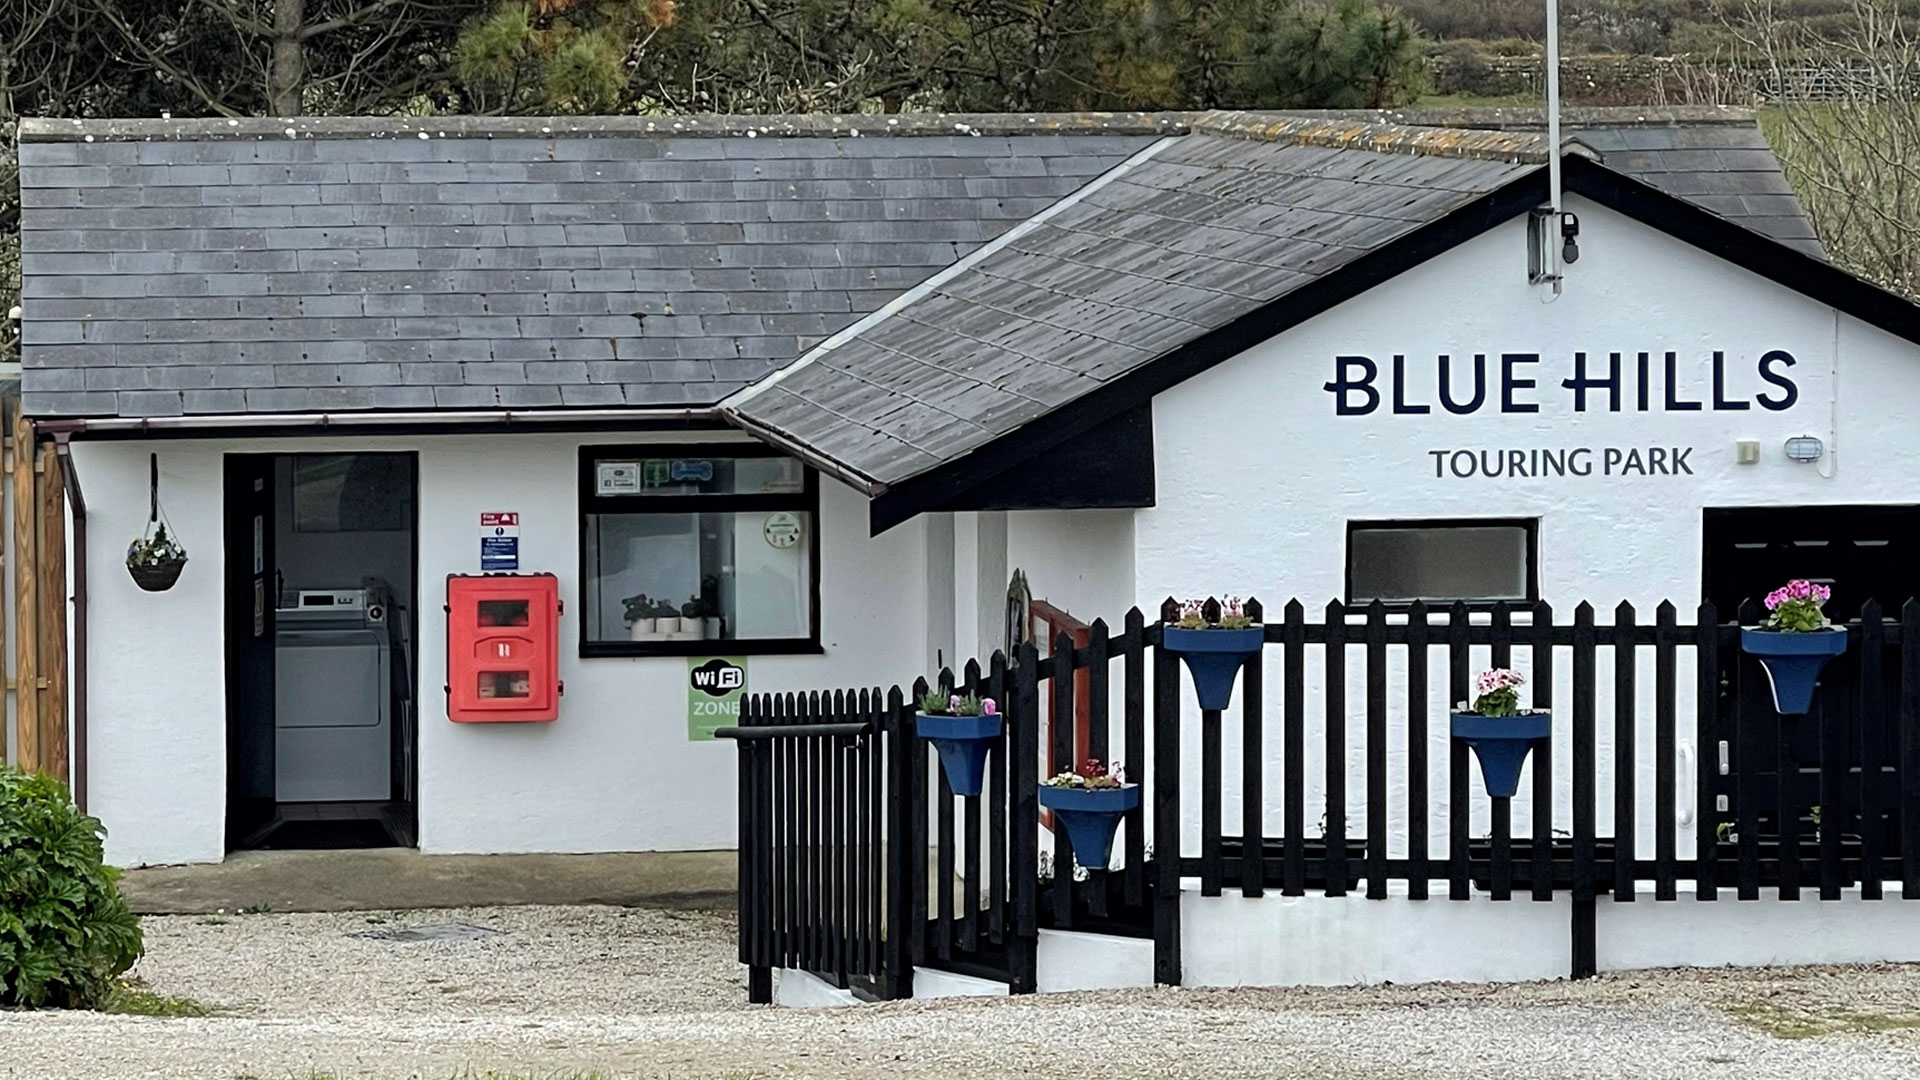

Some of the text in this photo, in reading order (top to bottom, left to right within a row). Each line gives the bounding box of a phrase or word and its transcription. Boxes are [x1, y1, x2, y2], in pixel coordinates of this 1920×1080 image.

[1323, 350, 1798, 415] BLUE HILLS
[1429, 448, 1693, 477] TOURING PARK
[693, 701, 740, 716] ZONE
